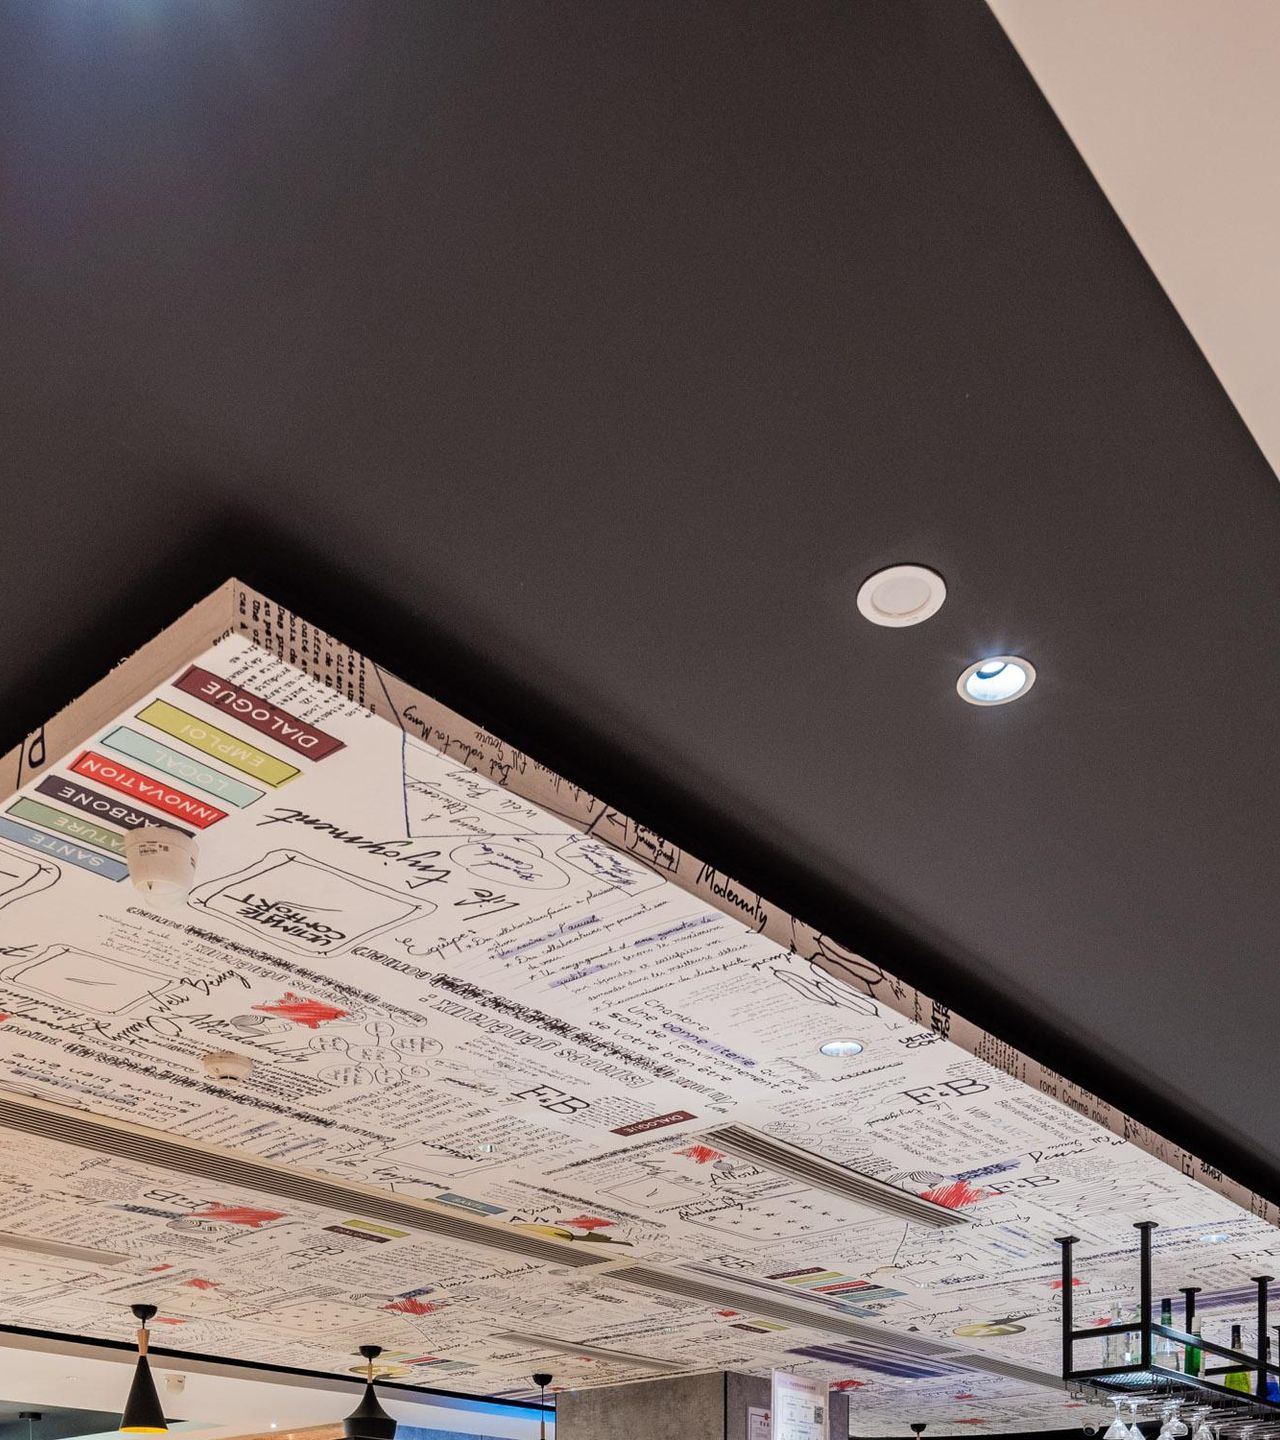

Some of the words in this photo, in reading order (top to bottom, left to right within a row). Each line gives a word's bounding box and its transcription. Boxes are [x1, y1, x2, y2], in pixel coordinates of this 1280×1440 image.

[345, 657, 366, 716] estauration
[201, 681, 318, 747] DIALOGUE
[181, 725, 265, 767] EMPLOI
[156, 750, 228, 791] LOCAL
[58, 787, 158, 828] ARBONE
[82, 760, 220, 823] INNOVATION
[28, 834, 105, 867] SANTE
[54, 816, 122, 848] ATURE
[256, 807, 451, 889] Enjoyment
[223, 894, 346, 939] COMFORT
[454, 887, 520, 921] Life
[696, 859, 769, 933] Modernity
[236, 907, 331, 946] ULTIMATE
[429, 999, 558, 1050] généraux
[644, 999, 709, 1031] Chambre
[663, 1022, 708, 1044] bonne
[554, 1049, 653, 1088] Espaces
[620, 1113, 692, 1135] DIALOGUE
